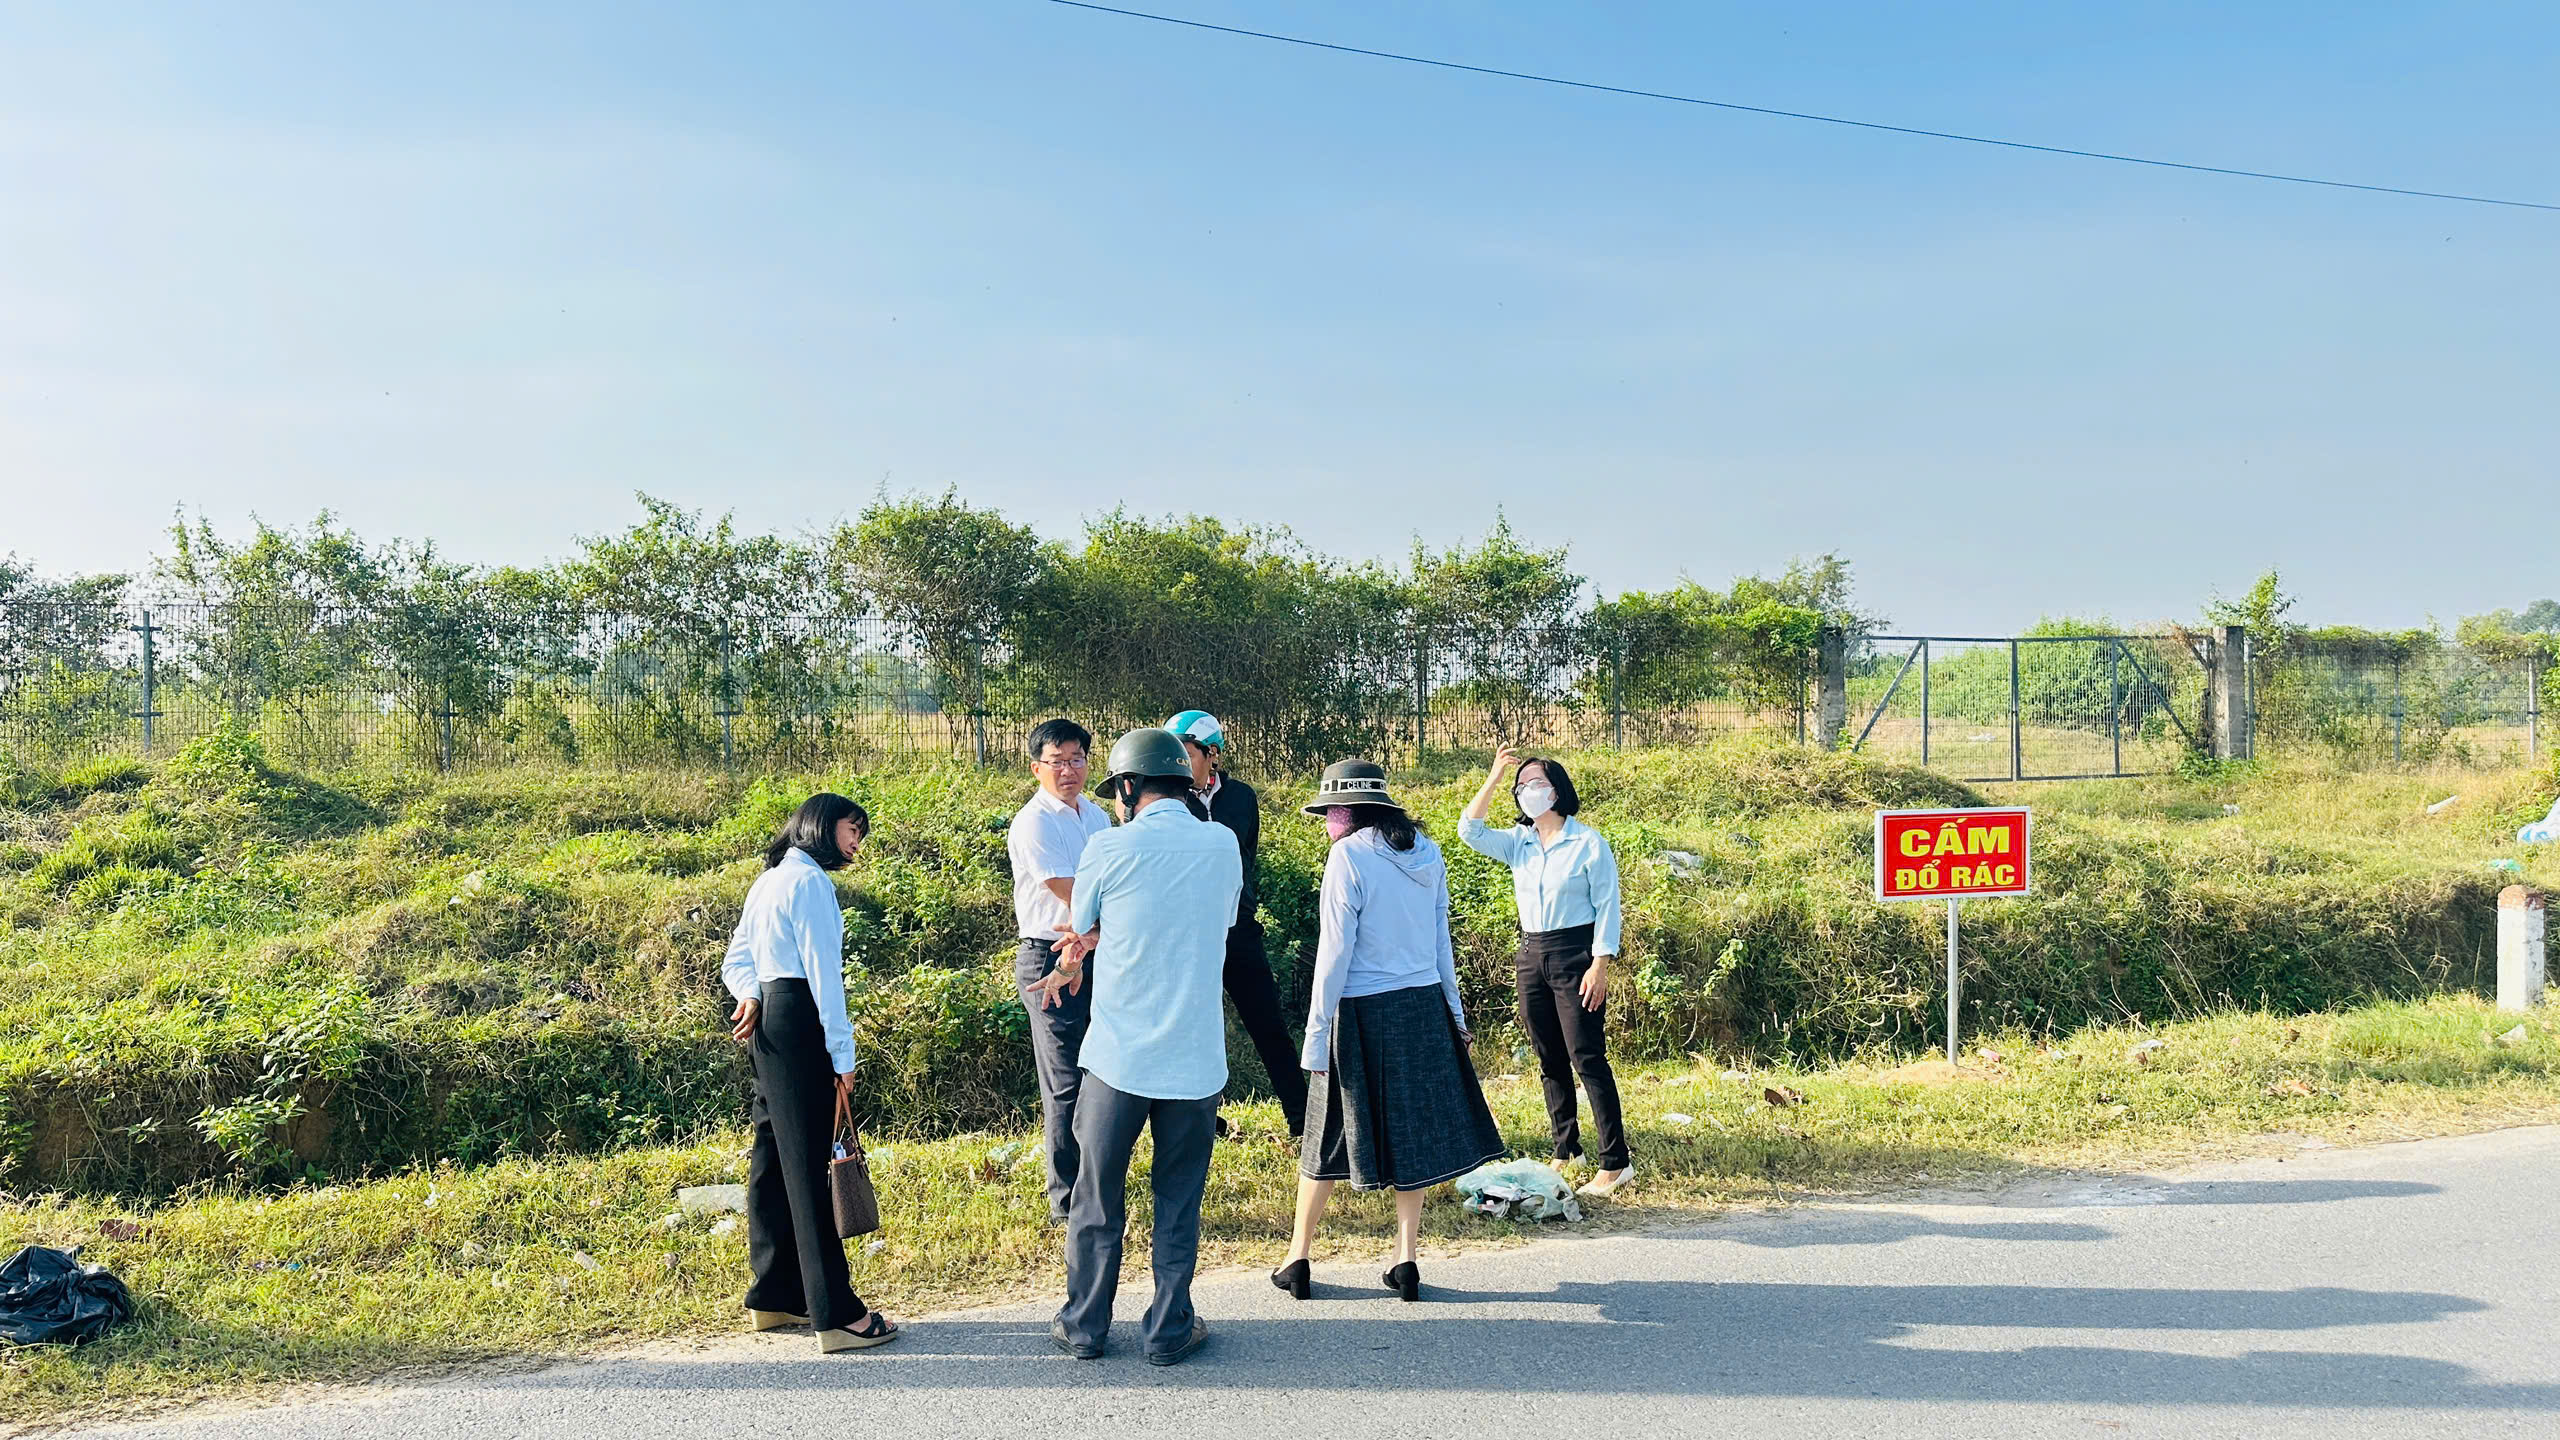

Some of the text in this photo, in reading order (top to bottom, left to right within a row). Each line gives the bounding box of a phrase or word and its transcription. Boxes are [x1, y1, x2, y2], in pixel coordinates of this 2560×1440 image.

[1347, 781, 1372, 790] CELINE
[1900, 817, 2010, 857] CẤM
[1895, 859, 2015, 890] ĐỔ RÁC
